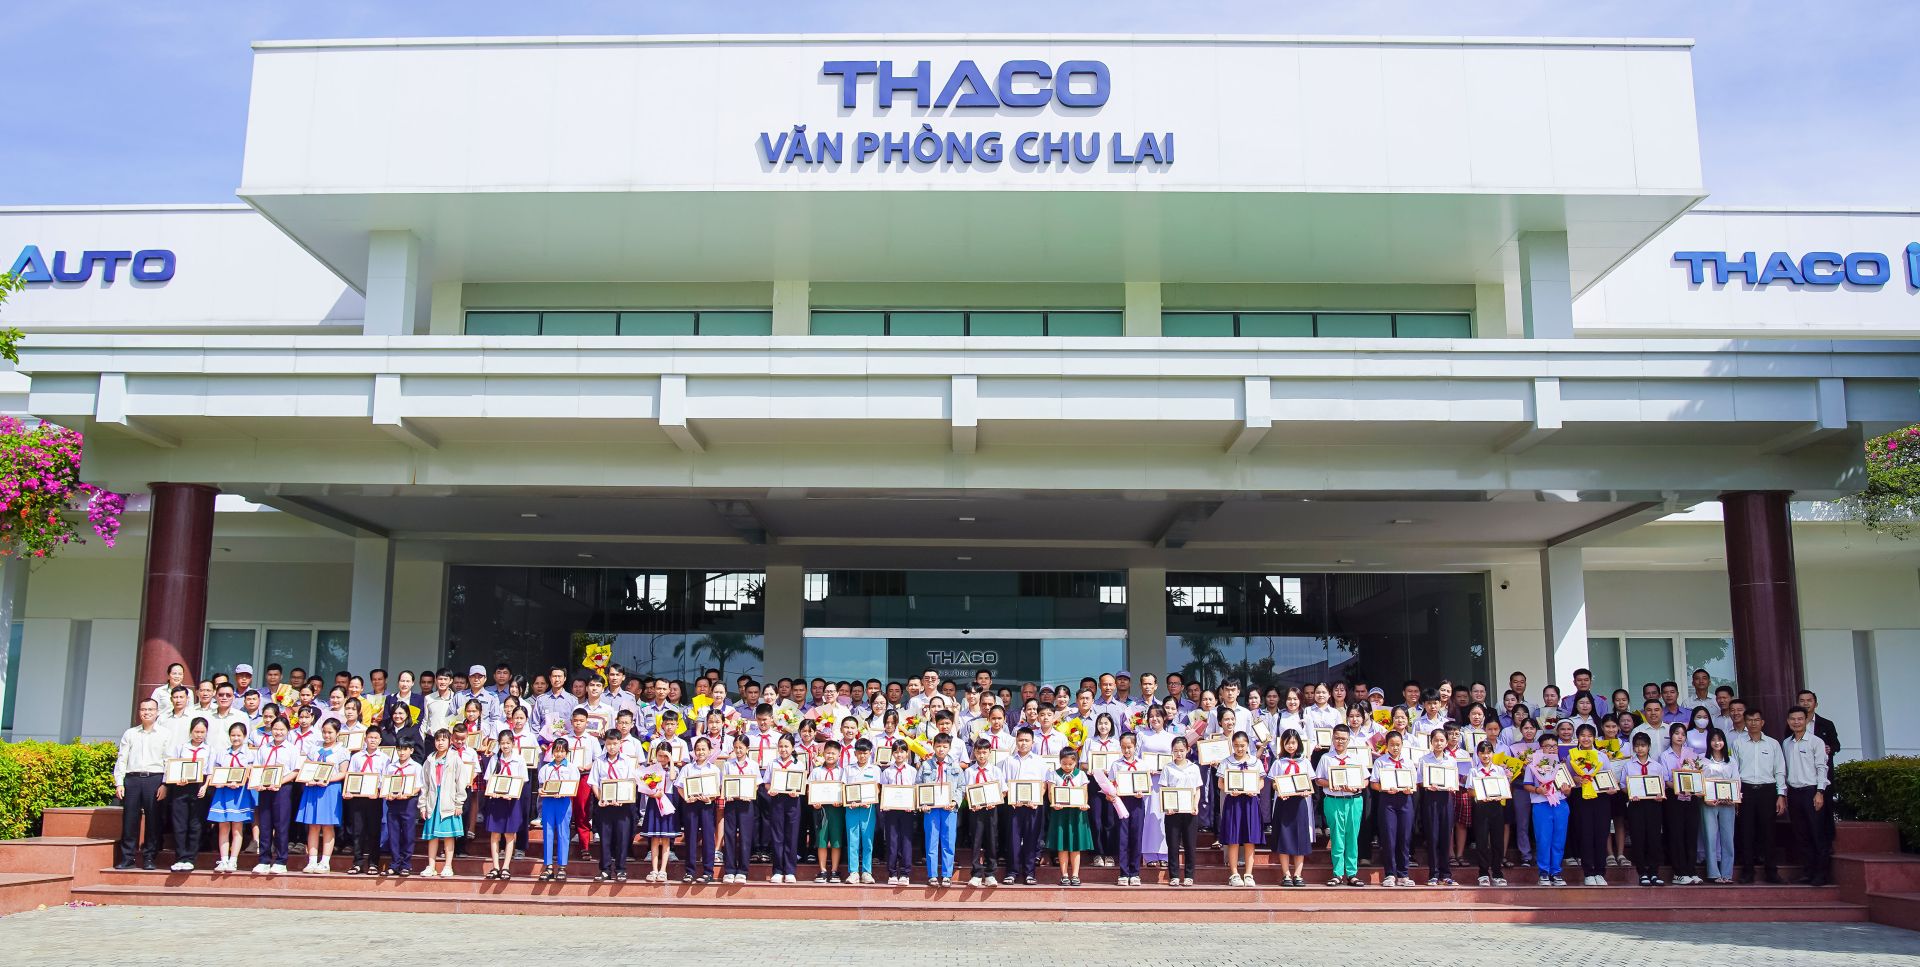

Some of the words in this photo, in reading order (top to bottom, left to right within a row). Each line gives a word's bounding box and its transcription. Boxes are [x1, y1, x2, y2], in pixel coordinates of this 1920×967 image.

[823, 60, 1111, 109] THACO
[760, 124, 843, 164] VĂN
[857, 123, 1003, 164] PHÒNG
[1015, 132, 1101, 164] CHU
[1113, 132, 1175, 164] LAI
[1674, 251, 1891, 286] THACO
[927, 651, 998, 665] THACO
